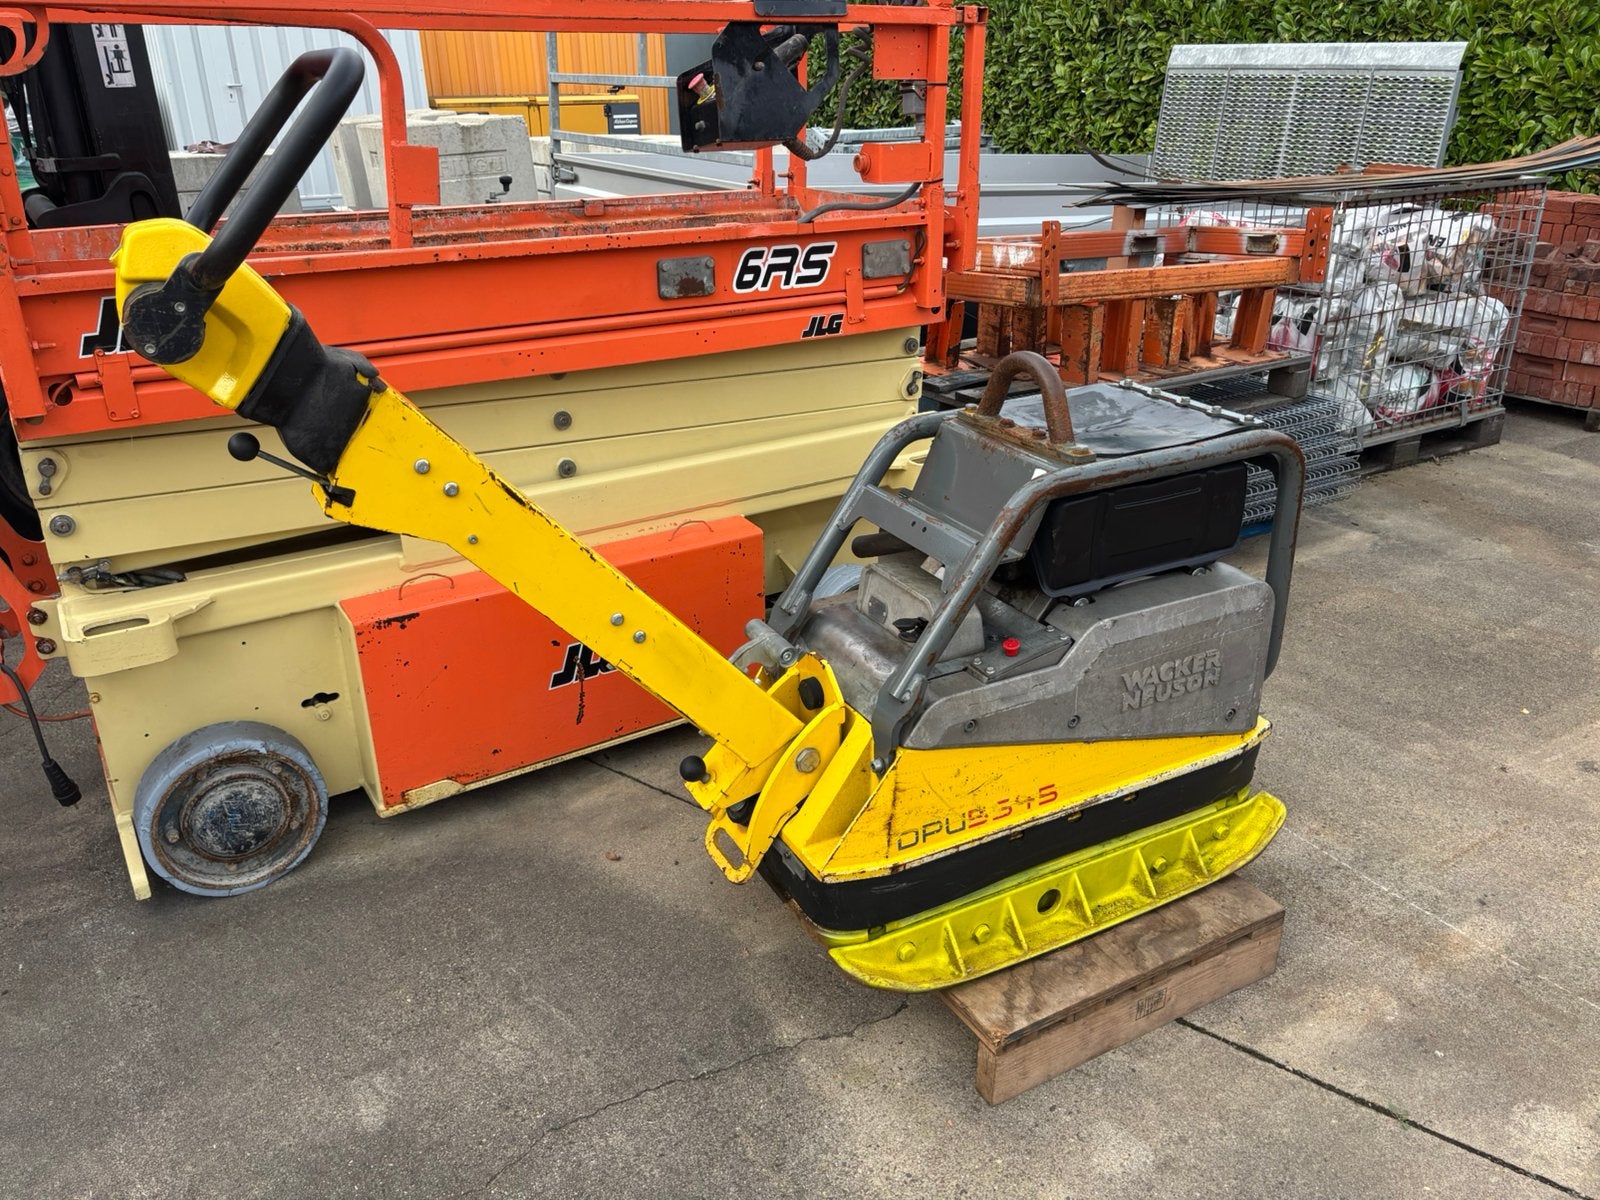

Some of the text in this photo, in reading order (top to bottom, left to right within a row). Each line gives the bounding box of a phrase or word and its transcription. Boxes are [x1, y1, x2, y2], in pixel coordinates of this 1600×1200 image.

[734, 242, 837, 292] 6RS
[801, 313, 844, 339] JLG
[1121, 649, 1221, 692] WACKER
[1121, 667, 1221, 712] NEUSON
